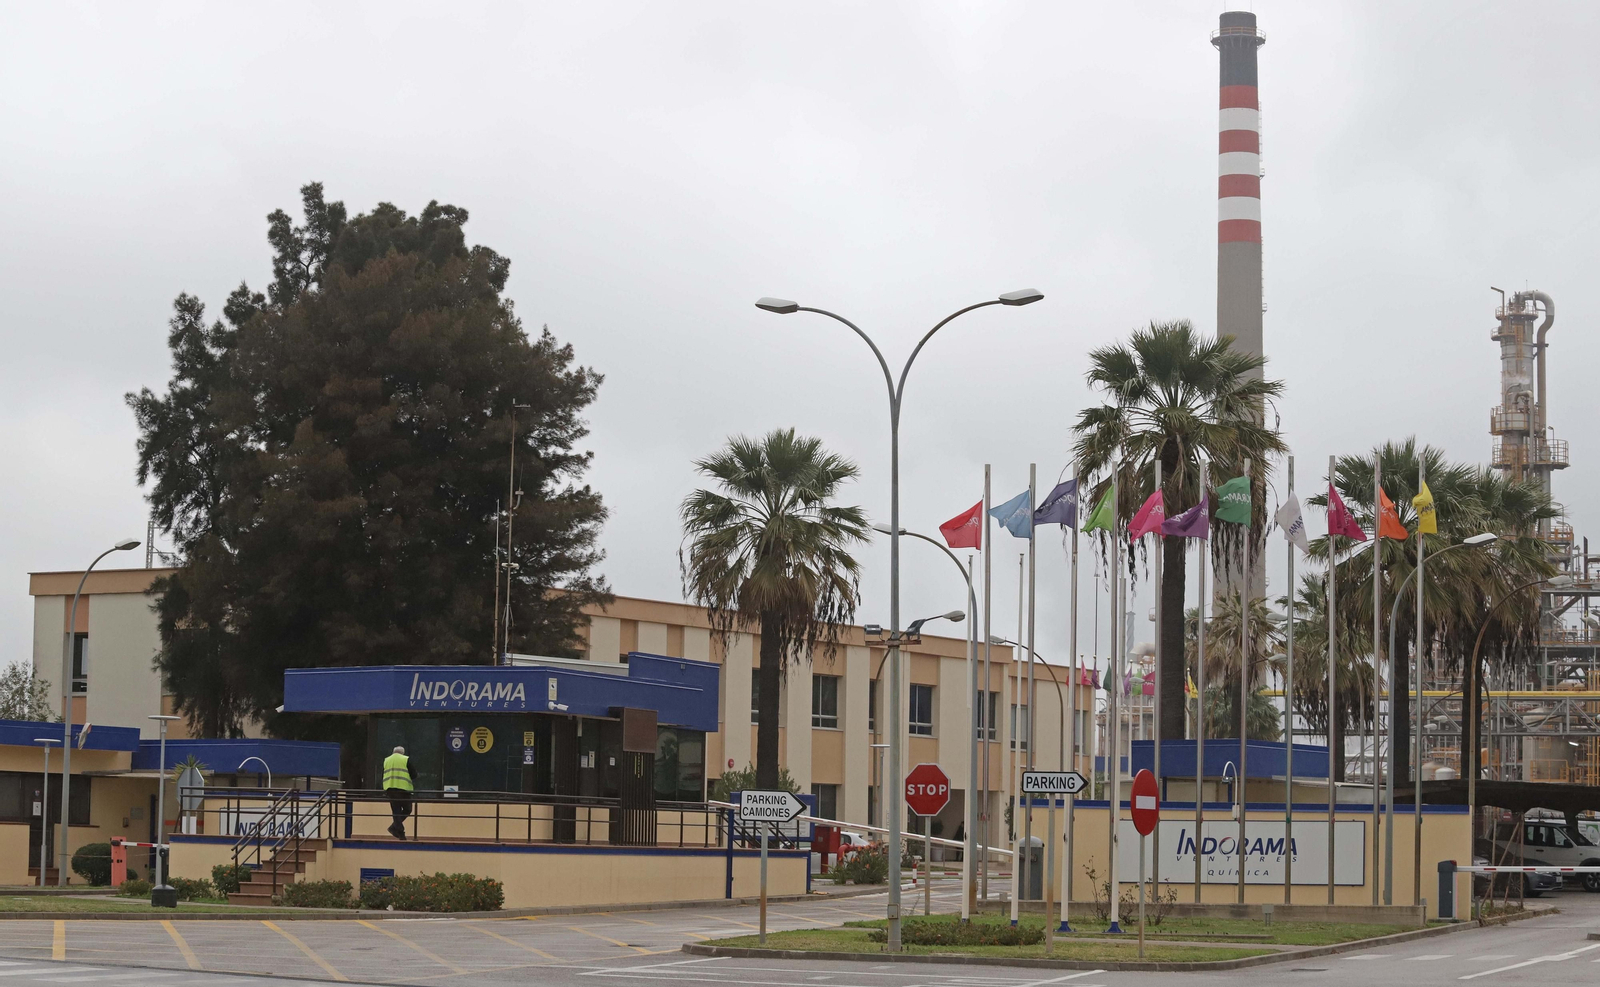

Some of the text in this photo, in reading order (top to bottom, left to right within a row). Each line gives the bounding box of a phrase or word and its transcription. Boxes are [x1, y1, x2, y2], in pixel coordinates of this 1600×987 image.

[409, 673, 526, 701] INDORAMA
[409, 700, 526, 708] VENTURES
[1026, 776, 1076, 789] PARKING
[907, 784, 947, 795] STOP
[746, 794, 787, 805] PARKING
[742, 806, 790, 817] CAMIONES
